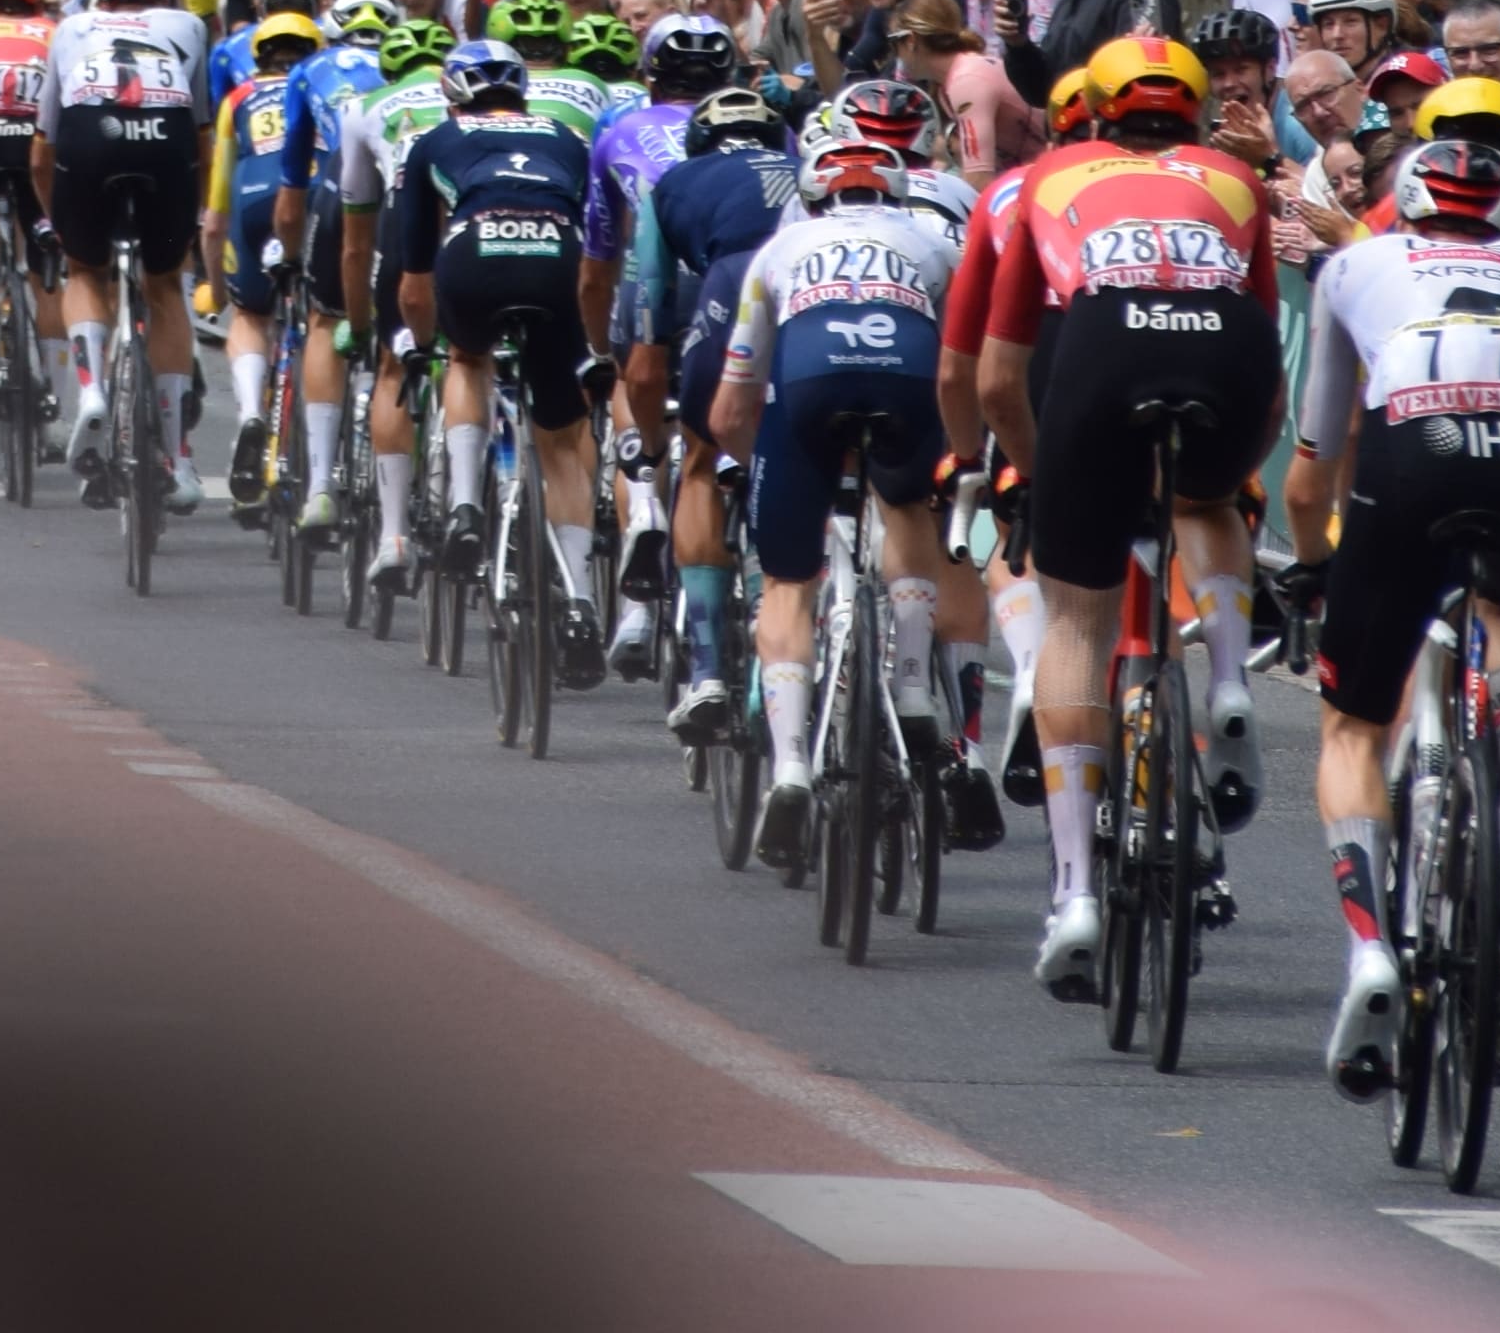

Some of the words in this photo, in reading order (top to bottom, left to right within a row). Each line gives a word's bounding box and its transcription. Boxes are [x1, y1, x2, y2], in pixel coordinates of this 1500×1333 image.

[16, 69, 43, 103] 12
[84, 59, 99, 83] 5
[158, 59, 173, 88] 5
[125, 118, 169, 141] IHC
[479, 221, 562, 241] BORA
[1085, 229, 1158, 273] 128
[1167, 229, 1242, 273] 128
[1417, 329, 1444, 382] 7
[1390, 387, 1459, 417] VELU
